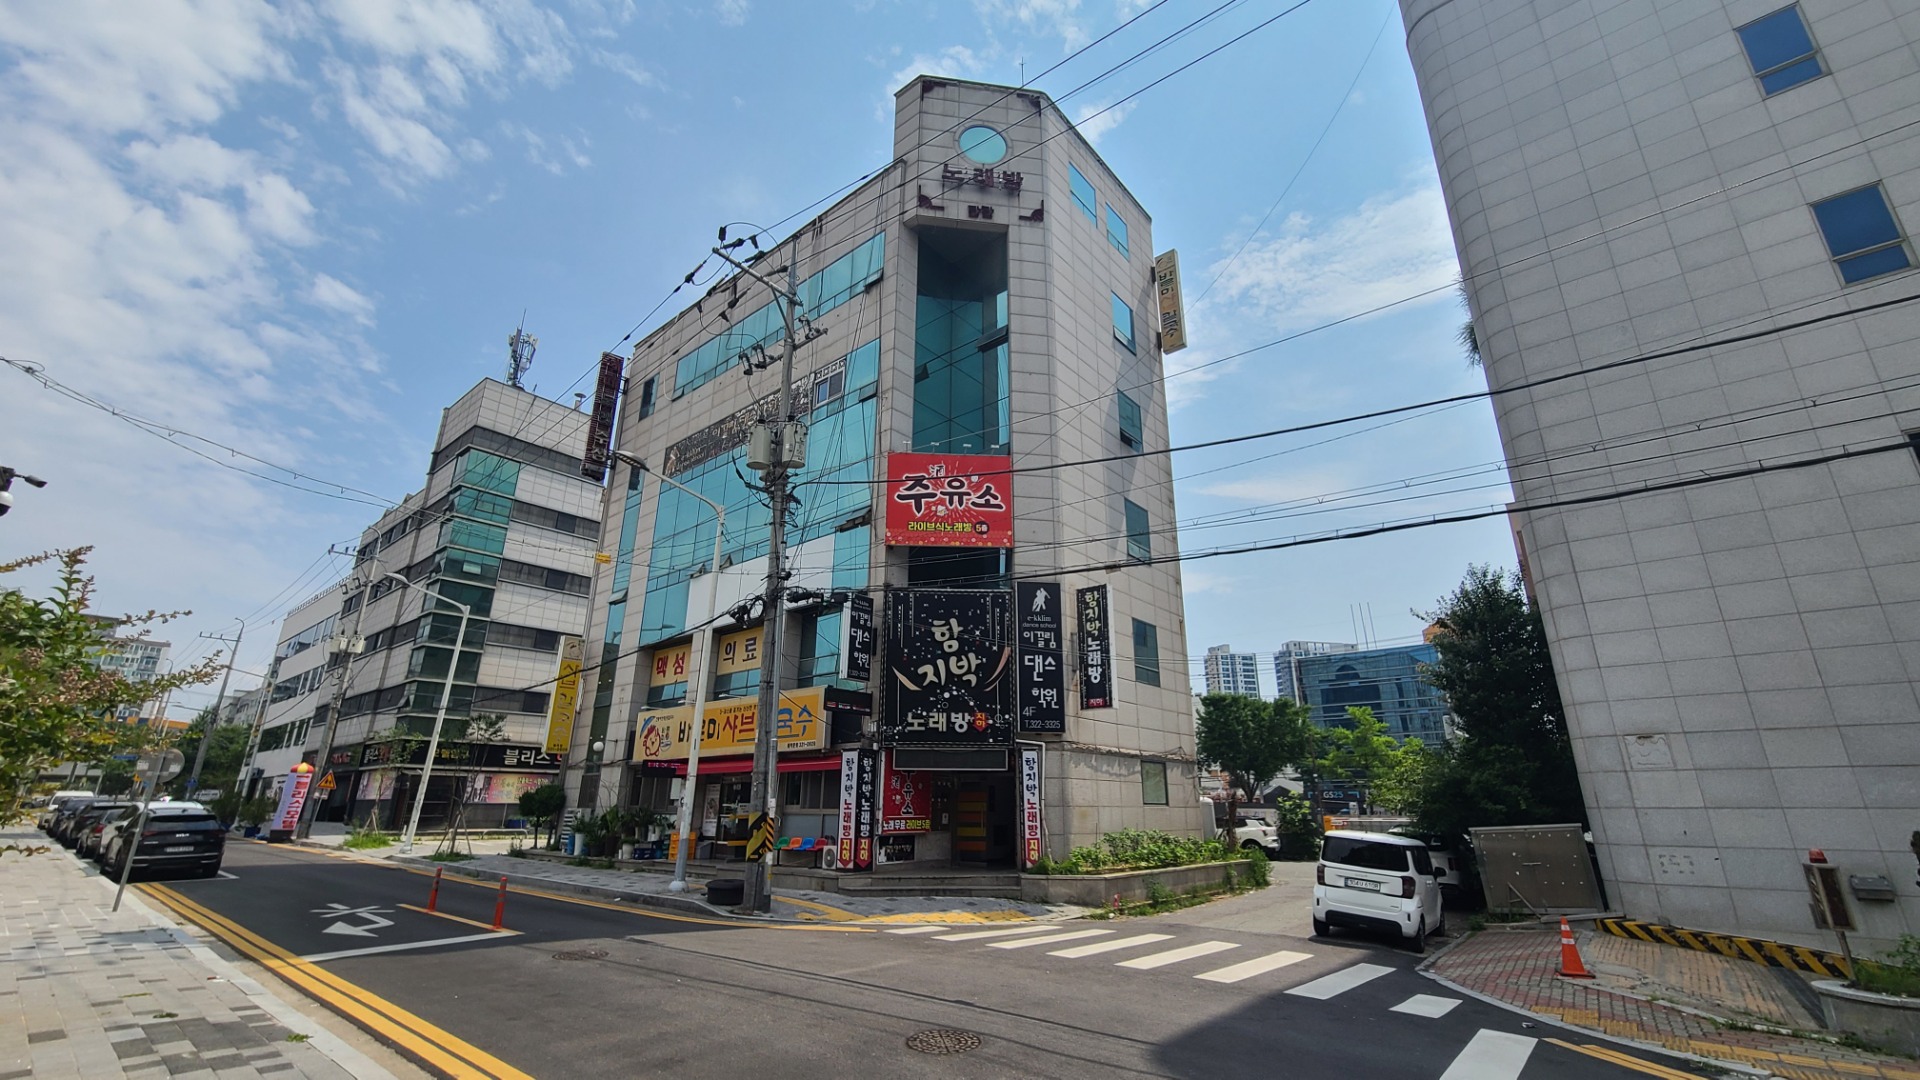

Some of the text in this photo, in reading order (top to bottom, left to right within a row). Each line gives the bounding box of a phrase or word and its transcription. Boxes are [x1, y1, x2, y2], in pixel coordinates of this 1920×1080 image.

[942, 164, 1023, 190] 노래방
[895, 474, 1005, 515] 주유소
[908, 521, 972, 532] 라이브식노래방
[852, 611, 871, 627] 이끌림
[851, 628, 870, 648] 댄스
[1023, 631, 1056, 648] 이끌림
[722, 636, 758, 664] 의료
[854, 652, 869, 669] 학원
[1024, 655, 1056, 681] 댄스
[1031, 688, 1059, 708] 학원
[1022, 706, 1036, 716] 4F
[907, 712, 985, 733] 노래방 지하
[1325, 791, 1348, 800] GS25
[841, 840, 850, 861] 지하
[859, 839, 868, 860] 지하
[1029, 840, 1039, 861] 지하
